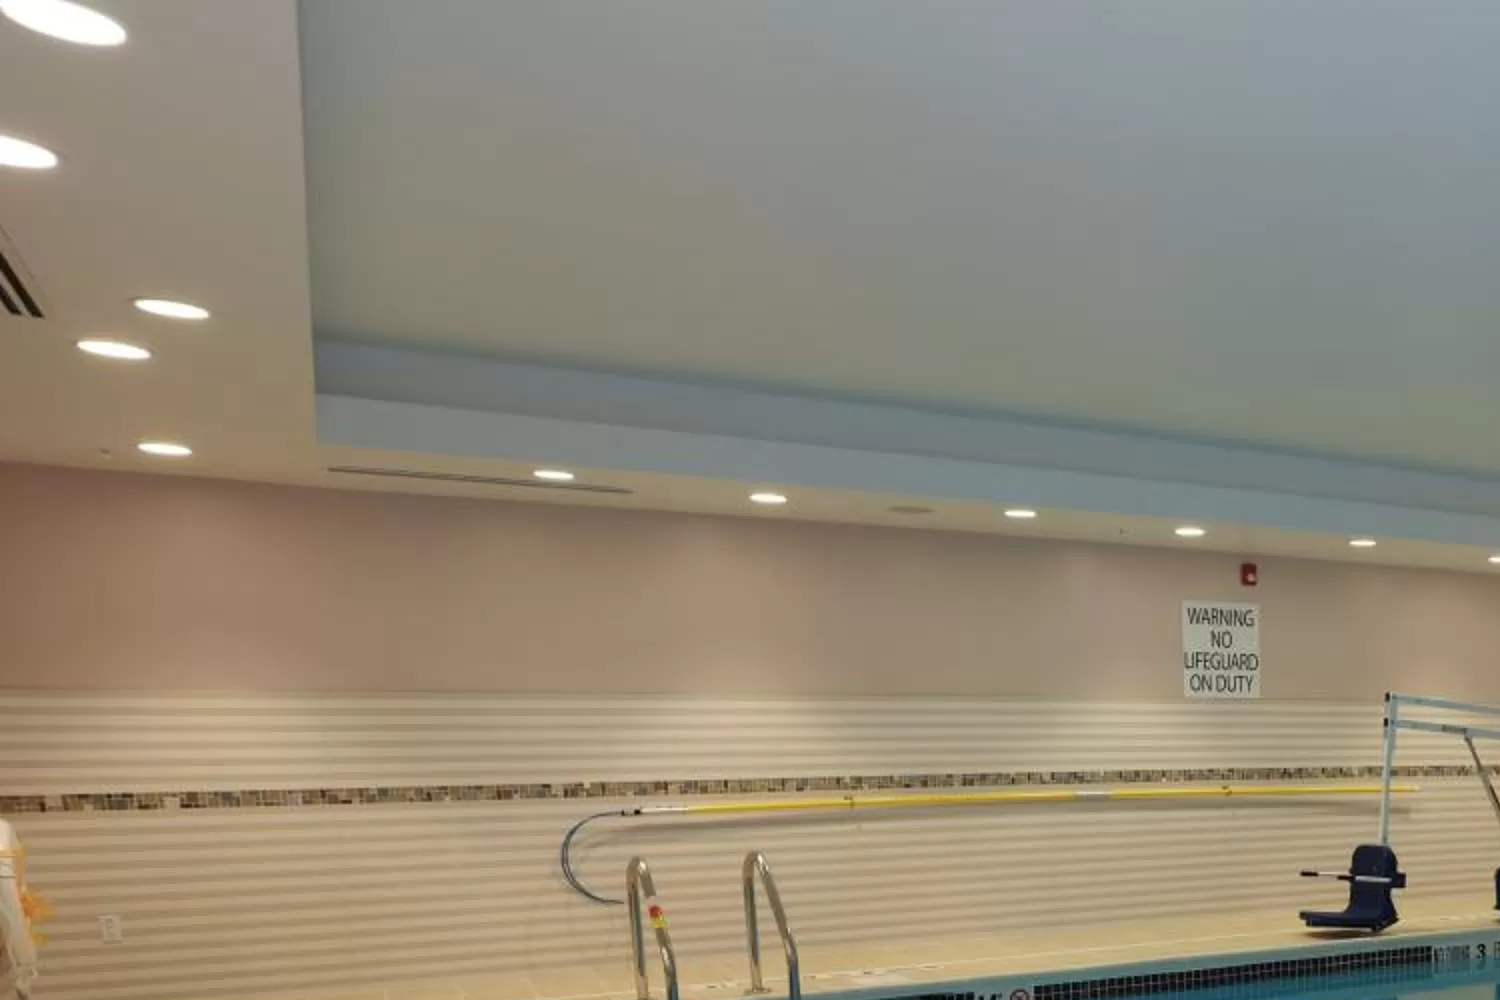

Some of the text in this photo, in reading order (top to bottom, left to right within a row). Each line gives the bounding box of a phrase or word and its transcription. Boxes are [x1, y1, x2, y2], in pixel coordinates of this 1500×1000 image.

[1187, 607, 1255, 627] WARNING
[1211, 630, 1233, 648] NO
[1184, 652, 1259, 671] LIFEGUARD
[1189, 674, 1254, 693] ON DUTY
